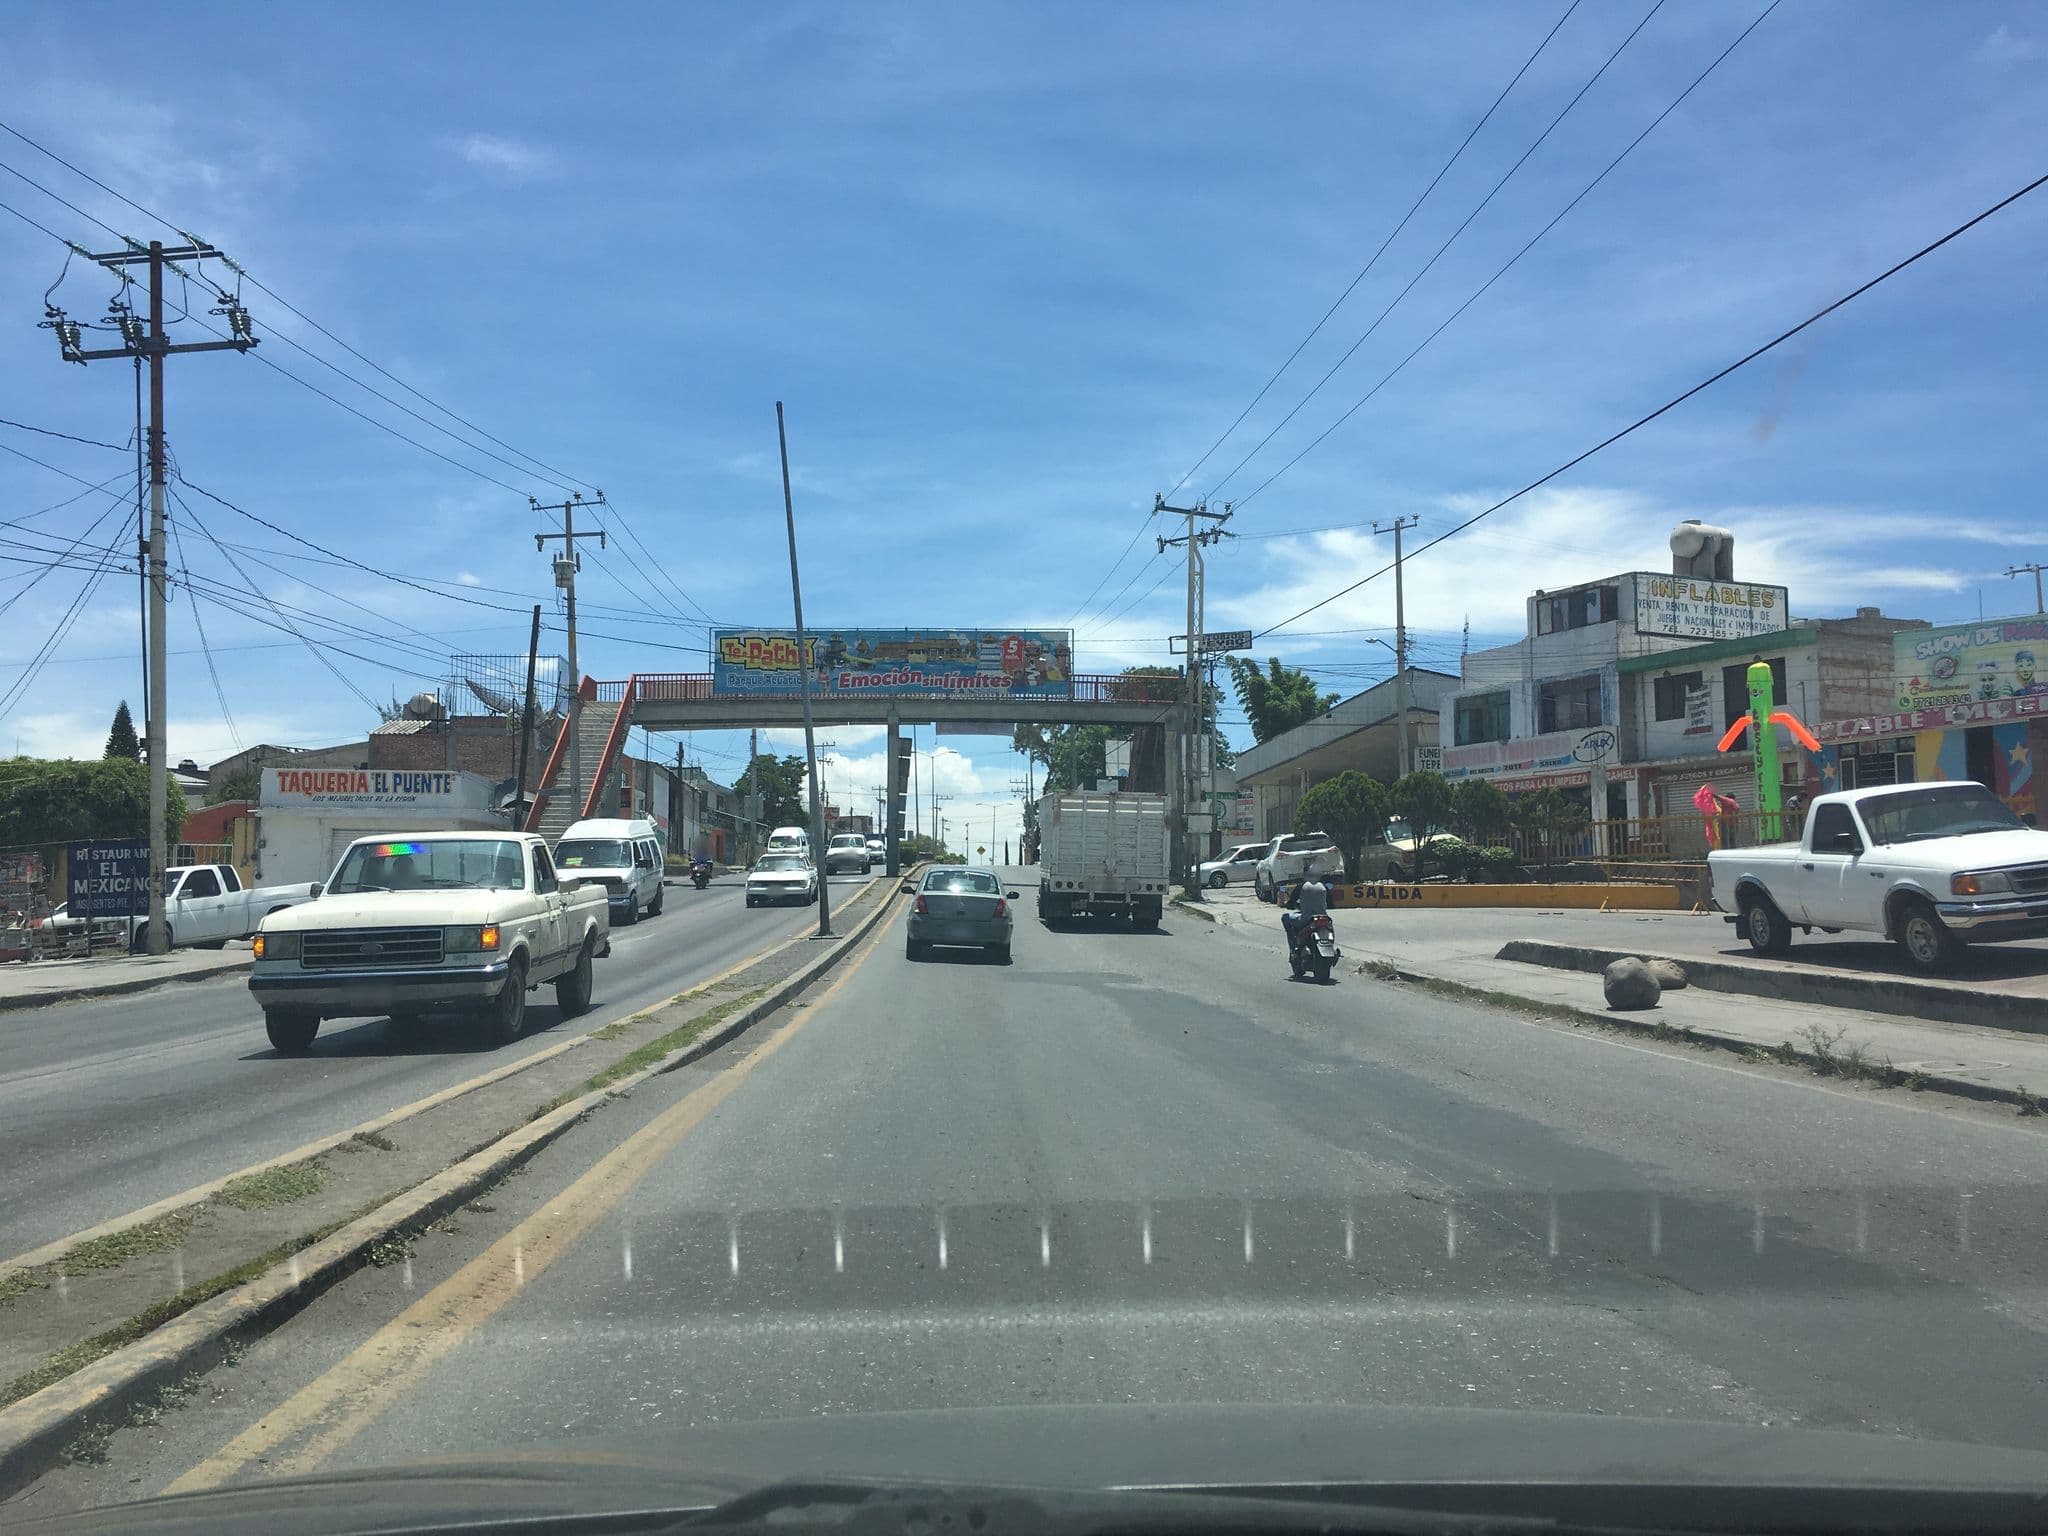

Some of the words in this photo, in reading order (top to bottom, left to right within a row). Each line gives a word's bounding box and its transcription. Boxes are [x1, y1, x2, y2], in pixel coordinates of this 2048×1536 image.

[1651, 579, 1775, 608] INFLABLES
[1665, 601, 1689, 613] RENTA
[1693, 604, 1700, 613] Y
[1760, 610, 1770, 621] DE
[1007, 640, 1018, 653] 5
[1916, 631, 1970, 660] SHOW
[1974, 625, 2001, 646] DE
[839, 667, 922, 689] Emoción
[922, 673, 943, 687] sin
[943, 671, 1013, 689] límites
[278, 771, 369, 797] TAQUERIA
[1514, 778, 1536, 792] PARA
[1537, 776, 1548, 789] LA
[1549, 773, 1588, 787] LIMPIEZA
[100, 861, 122, 876] EL
[1353, 885, 1422, 900] SALIDA
